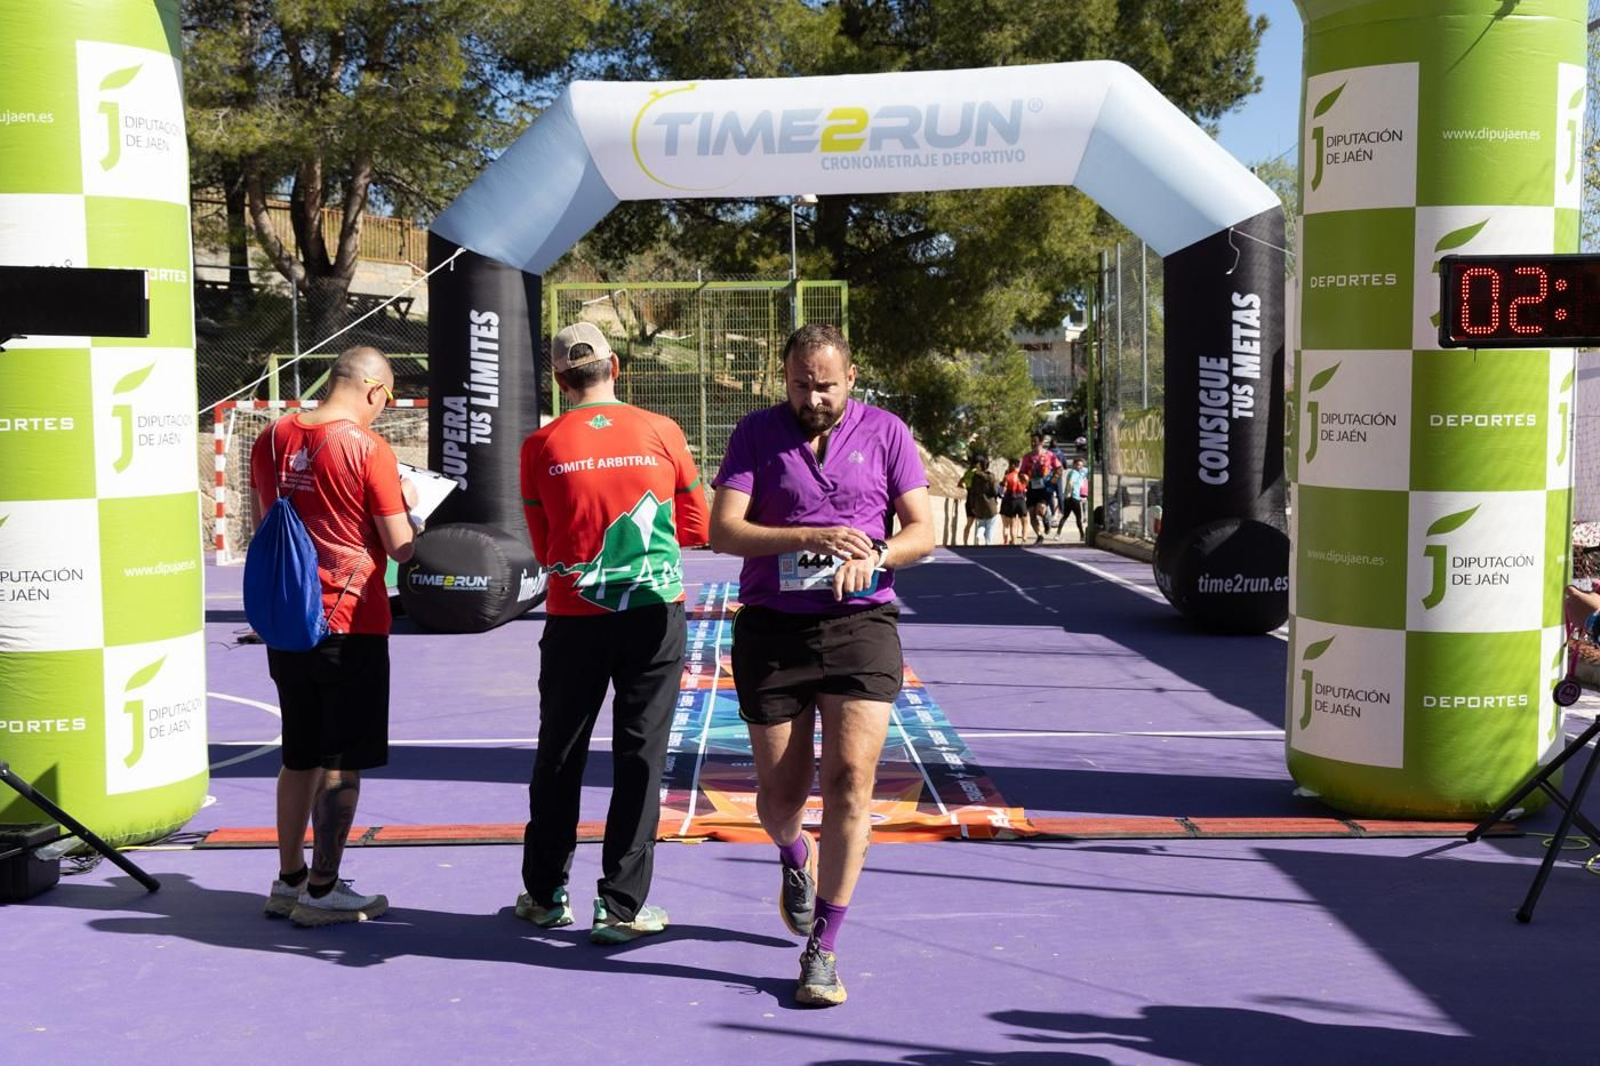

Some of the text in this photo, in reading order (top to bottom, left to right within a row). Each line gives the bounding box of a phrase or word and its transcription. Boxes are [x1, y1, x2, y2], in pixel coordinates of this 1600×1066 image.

[126, 134, 142, 148] DE
[1326, 128, 1403, 148] DIPUTACIÓN
[1442, 127, 1541, 142] www.dipujaen.es
[820, 148, 1025, 171] CRONOMETRAJE DEPORTIVO
[1326, 149, 1373, 165] DE JAÉN
[1310, 273, 1397, 288] DEPORTES
[1232, 292, 1261, 419] TUS METAS
[464, 309, 500, 444] TUS LÍMITES
[1198, 355, 1230, 486] CONSIGUE
[1321, 412, 1397, 427] DIPUTACIÓN
[1430, 413, 1537, 428] DEPORTES
[138, 433, 155, 447] DE
[1320, 428, 1367, 443] DE JAÉN
[549, 455, 659, 476] COMITÉ ARBITRAL
[798, 553, 834, 569] 444
[1307, 549, 1385, 566] www.dipujaen.es
[1452, 554, 1535, 569] DIPUTACIÓN
[1198, 573, 1289, 593] time2run.es
[1452, 571, 1510, 586] DE JAÉN
[9, 586, 50, 602] JAÉN
[1315, 682, 1391, 705] DIPUTACIÓN
[1424, 694, 1528, 708] DEPORTES
[1315, 700, 1361, 718] DE JAÉN
[149, 725, 165, 739] DE
